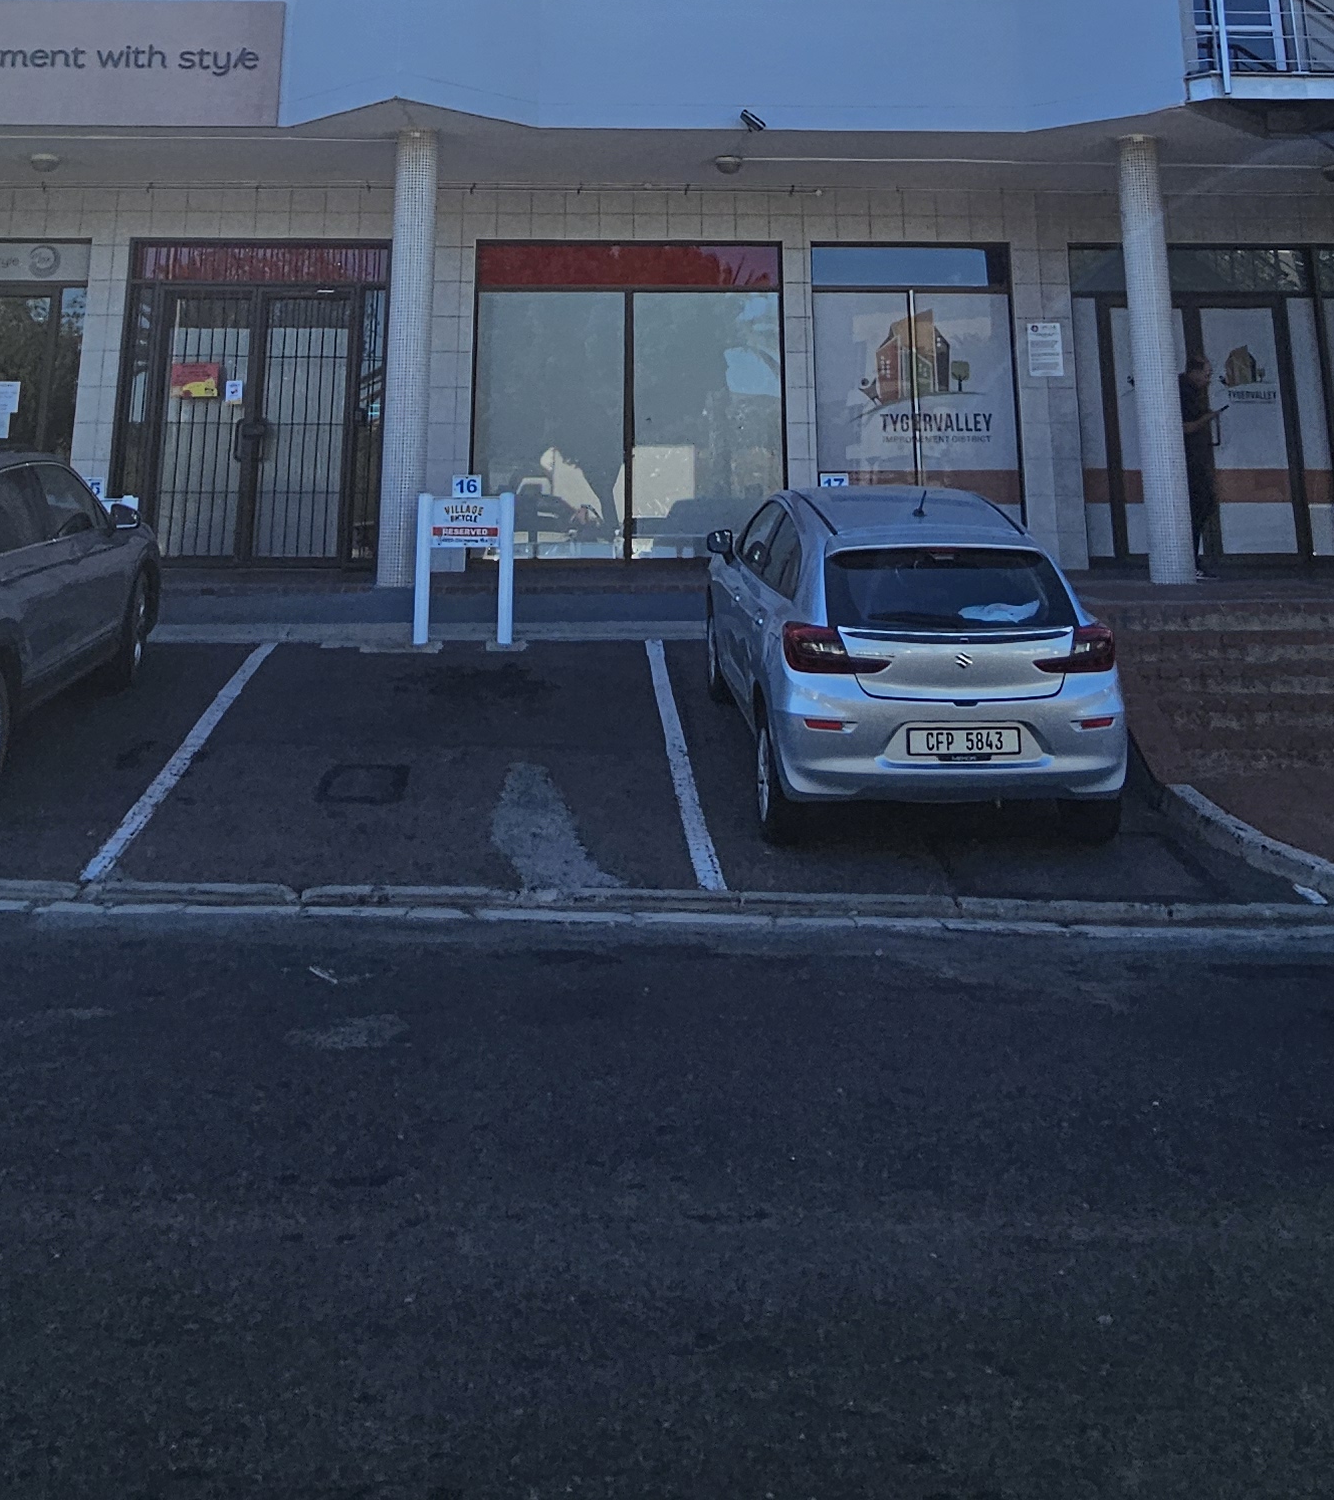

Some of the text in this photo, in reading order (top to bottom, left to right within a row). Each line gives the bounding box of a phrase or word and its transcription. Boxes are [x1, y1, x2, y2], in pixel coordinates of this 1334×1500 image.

[96, 45, 167, 69] with
[177, 46, 260, 76] style
[456, 479, 478, 494] 16
[823, 478, 844, 487] 17
[444, 504, 484, 516] VILLAGE
[442, 528, 488, 536] RESERVED
[926, 731, 1003, 751] CFP 5843
